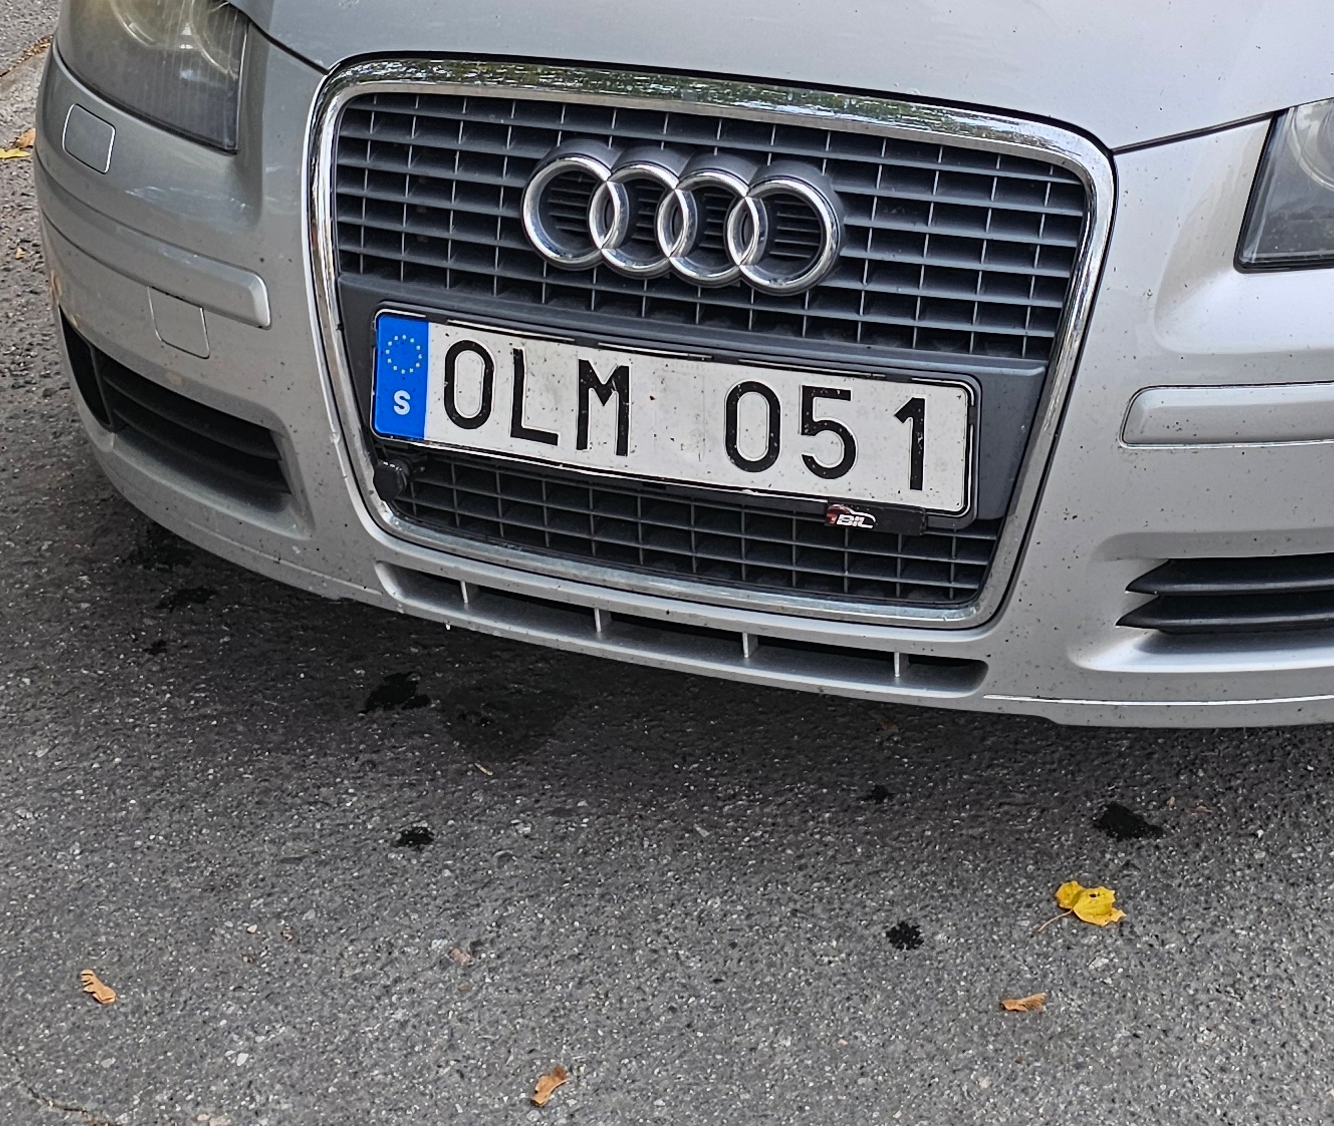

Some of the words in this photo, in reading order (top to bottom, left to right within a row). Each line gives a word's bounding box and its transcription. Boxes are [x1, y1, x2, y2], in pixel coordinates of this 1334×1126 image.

[394, 390, 411, 415] S
[444, 340, 629, 456] OLM
[725, 381, 925, 491] 051
